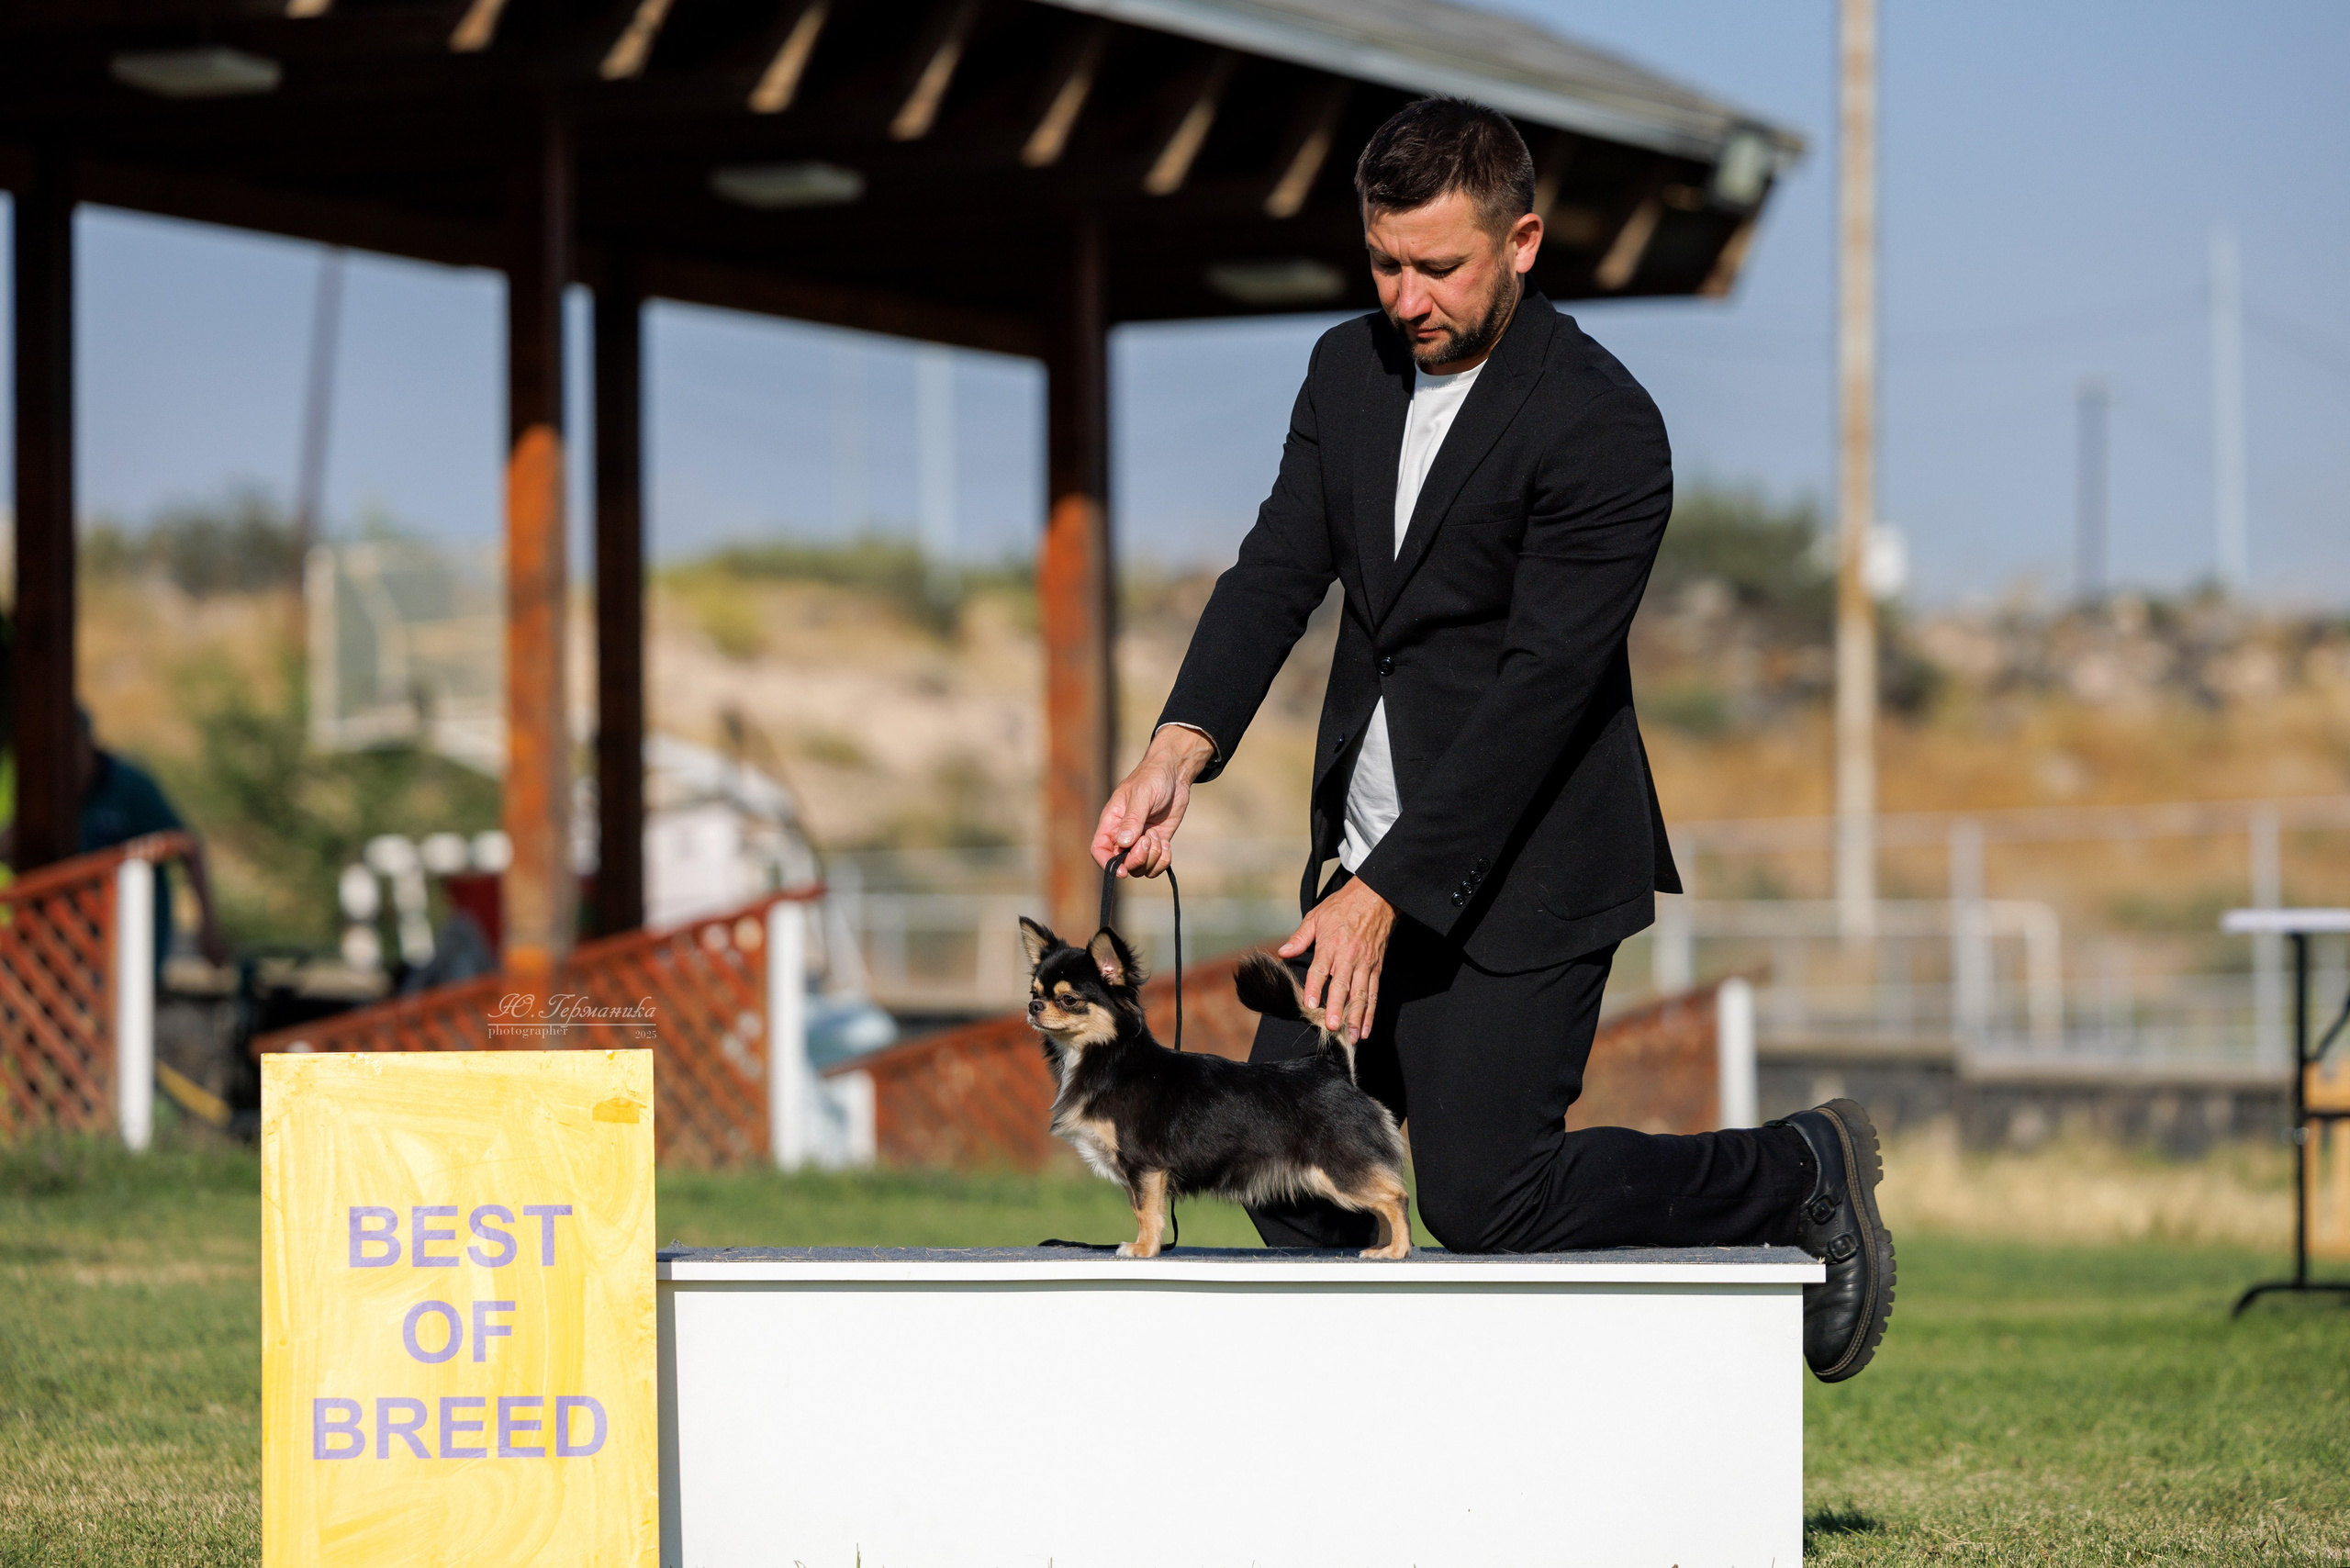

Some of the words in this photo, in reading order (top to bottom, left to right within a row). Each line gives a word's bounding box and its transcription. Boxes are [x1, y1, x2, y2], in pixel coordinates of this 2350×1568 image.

[348, 1204, 573, 1268] BEST
[402, 1300, 516, 1364] OF
[313, 1394, 609, 1461] BREED
